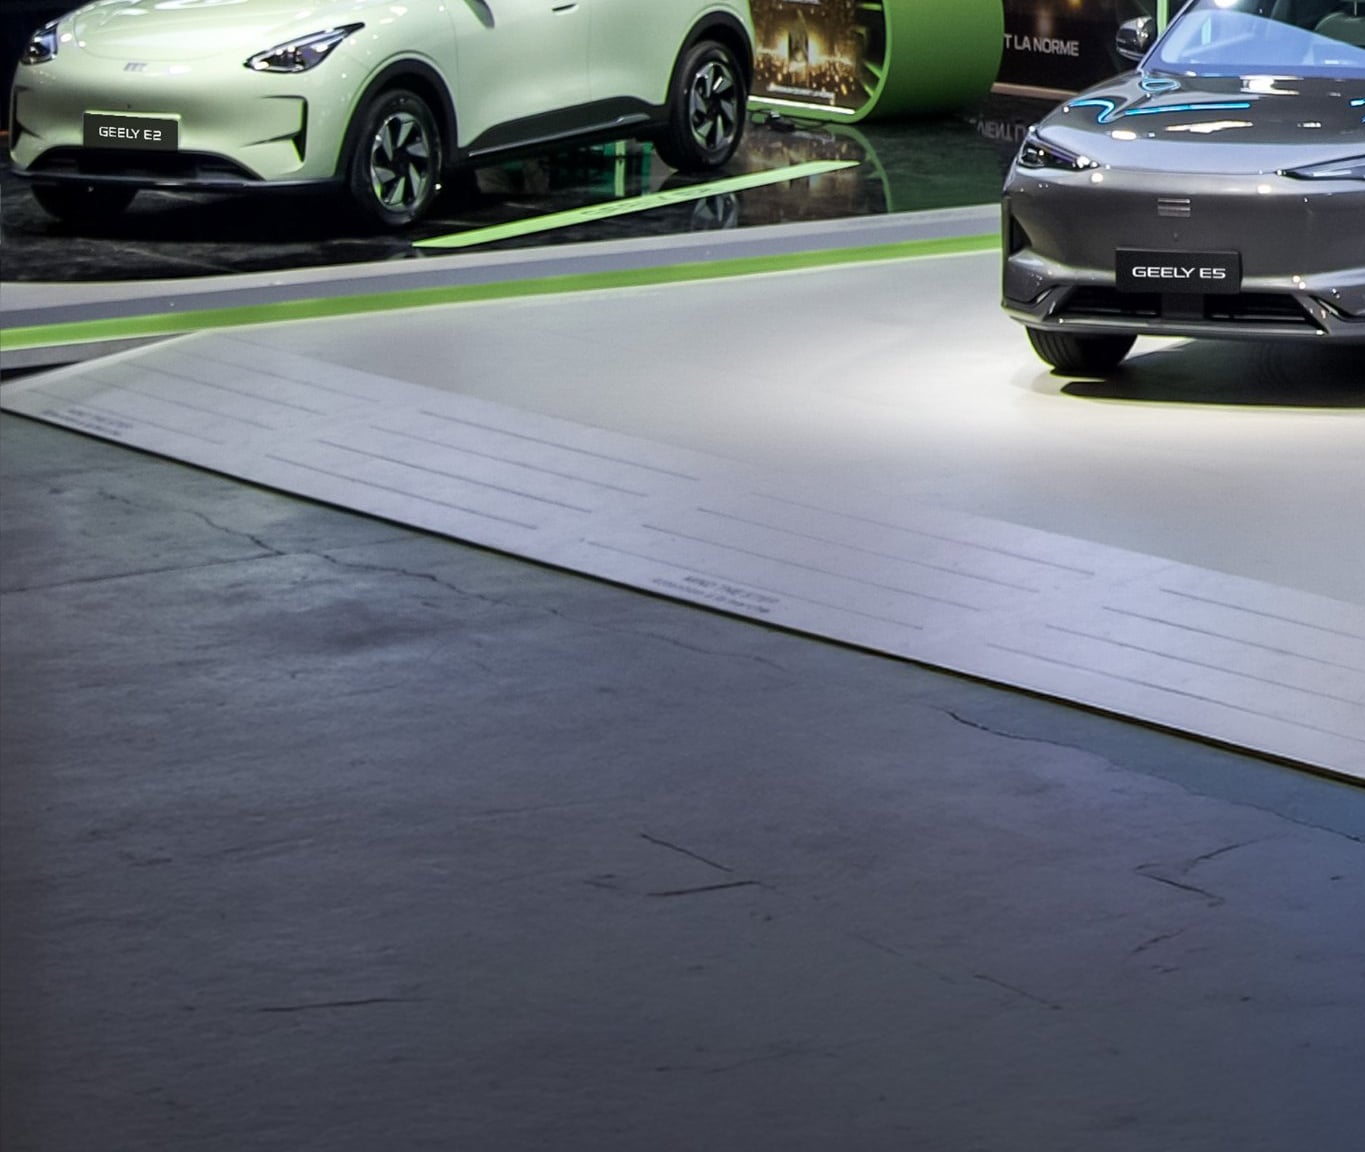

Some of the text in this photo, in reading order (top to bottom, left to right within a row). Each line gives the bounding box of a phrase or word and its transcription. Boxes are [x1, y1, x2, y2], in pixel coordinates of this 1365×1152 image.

[1014, 34, 1032, 51] LA
[1033, 37, 1080, 57] NORME
[98, 126, 162, 141] GEELY E2
[1132, 266, 1226, 279] GEELY E5
